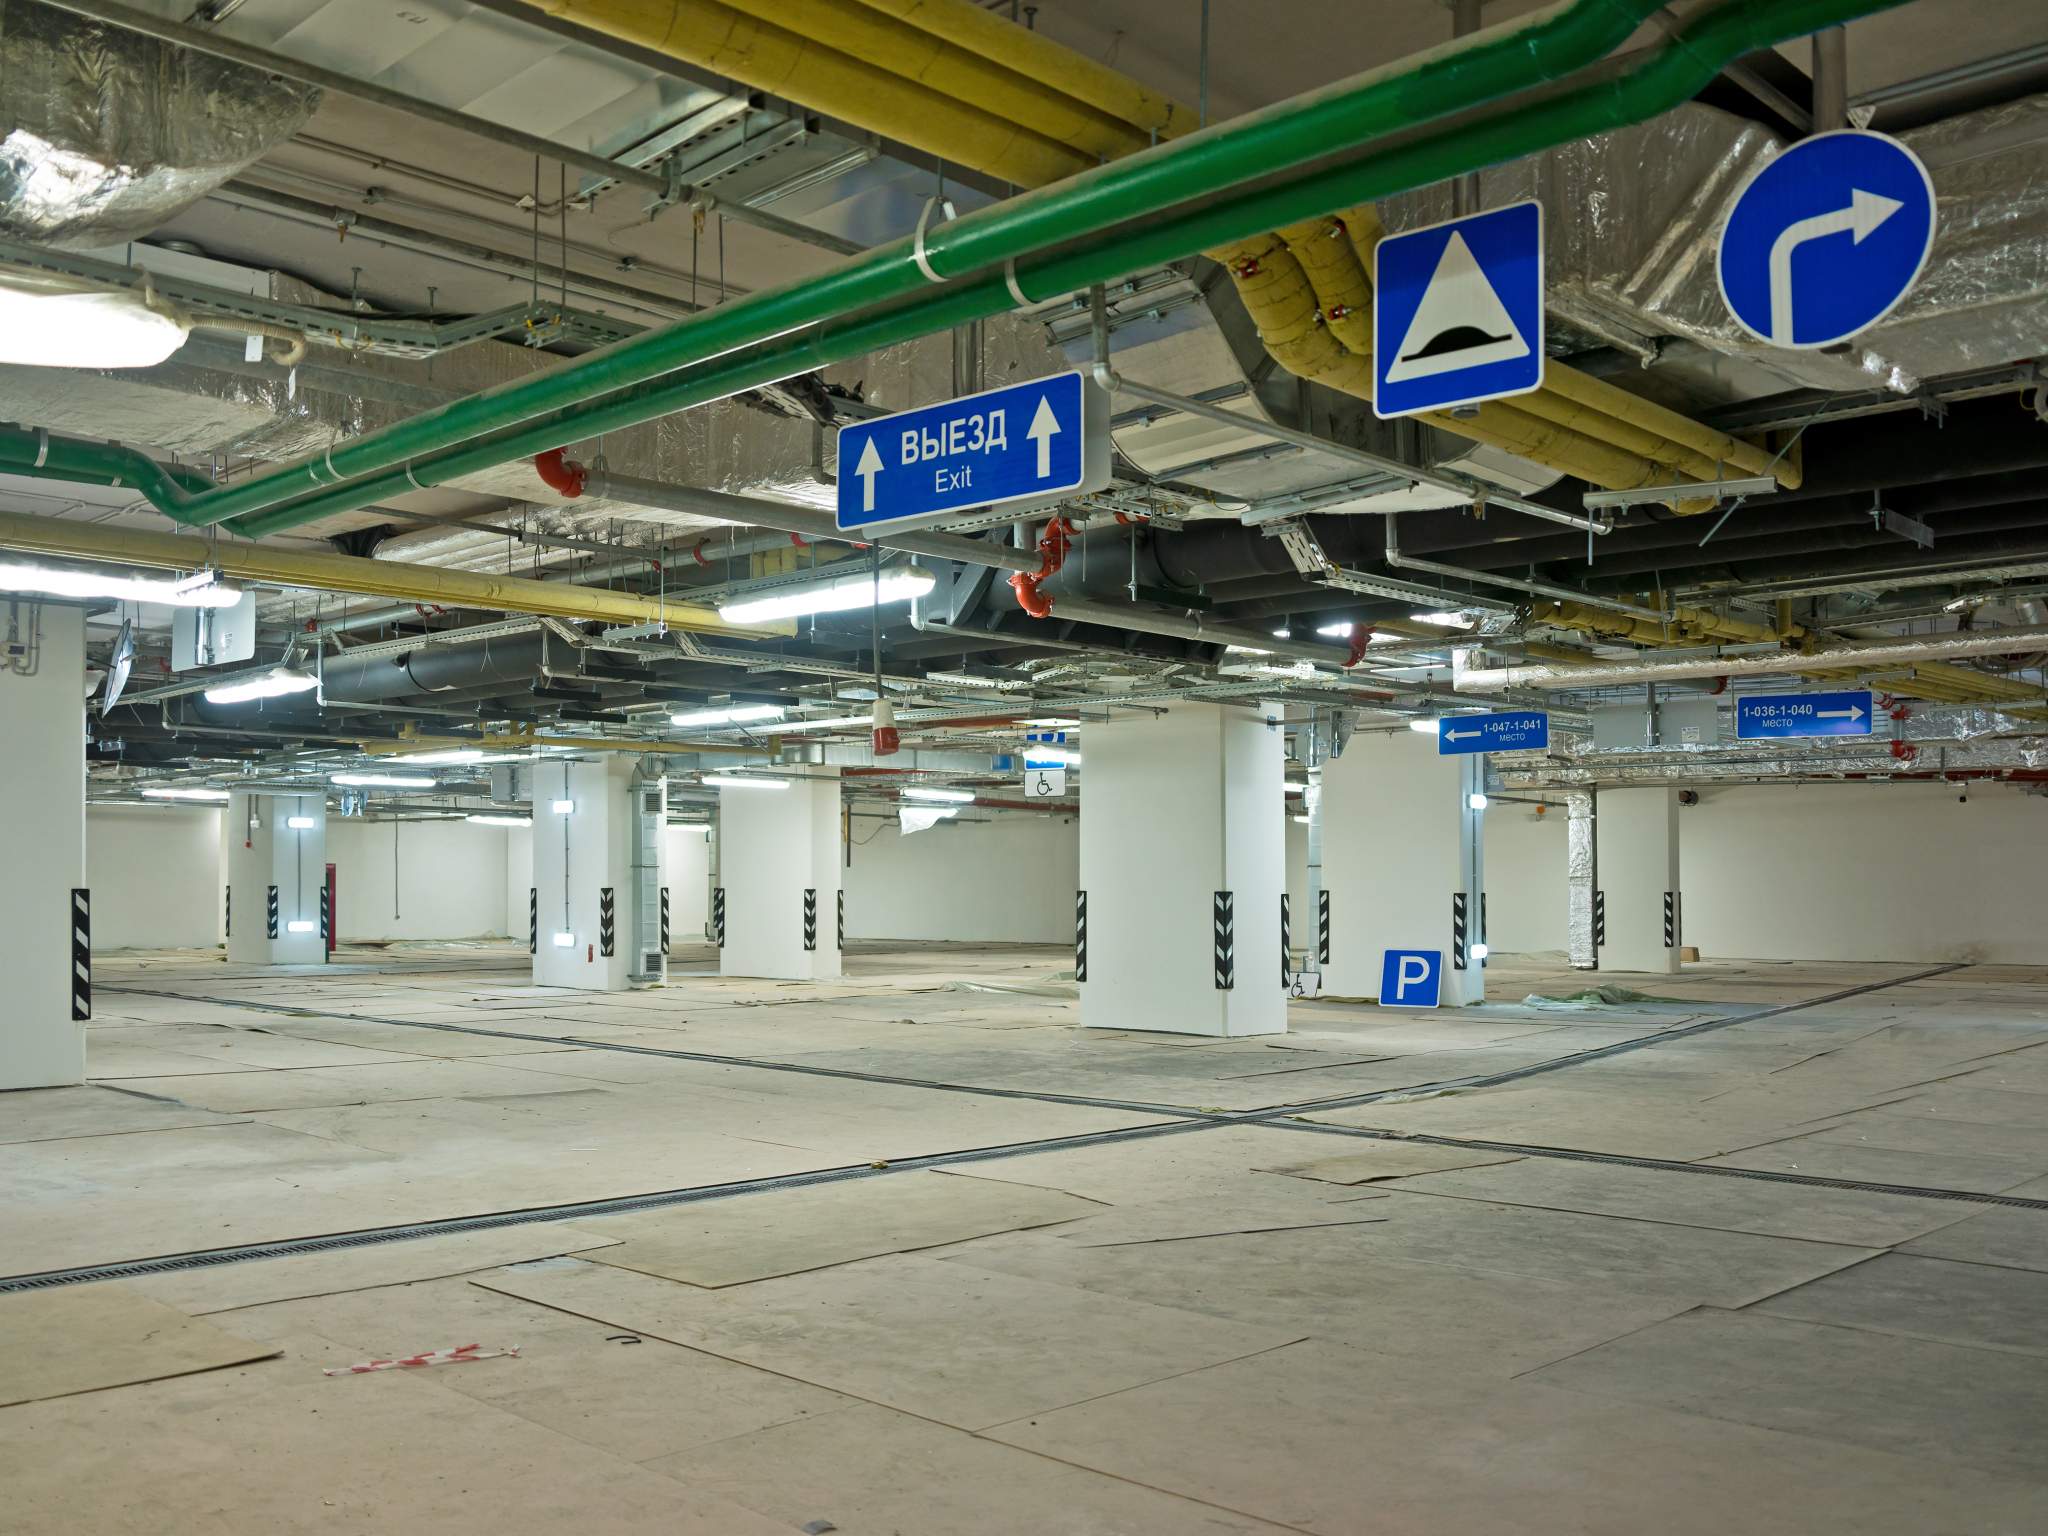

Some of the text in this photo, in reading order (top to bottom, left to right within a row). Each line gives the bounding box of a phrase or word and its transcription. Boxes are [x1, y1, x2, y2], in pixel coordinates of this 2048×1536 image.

[901, 409, 1007, 465] ВЫЕЗД
[935, 465, 972, 493] Exit
[1743, 704, 1813, 717] 1-036-1-040
[1483, 719, 1541, 733] 1-047-1-041
[1762, 718, 1793, 728] место
[1499, 733, 1526, 742] место
[1397, 955, 1431, 1000] P
